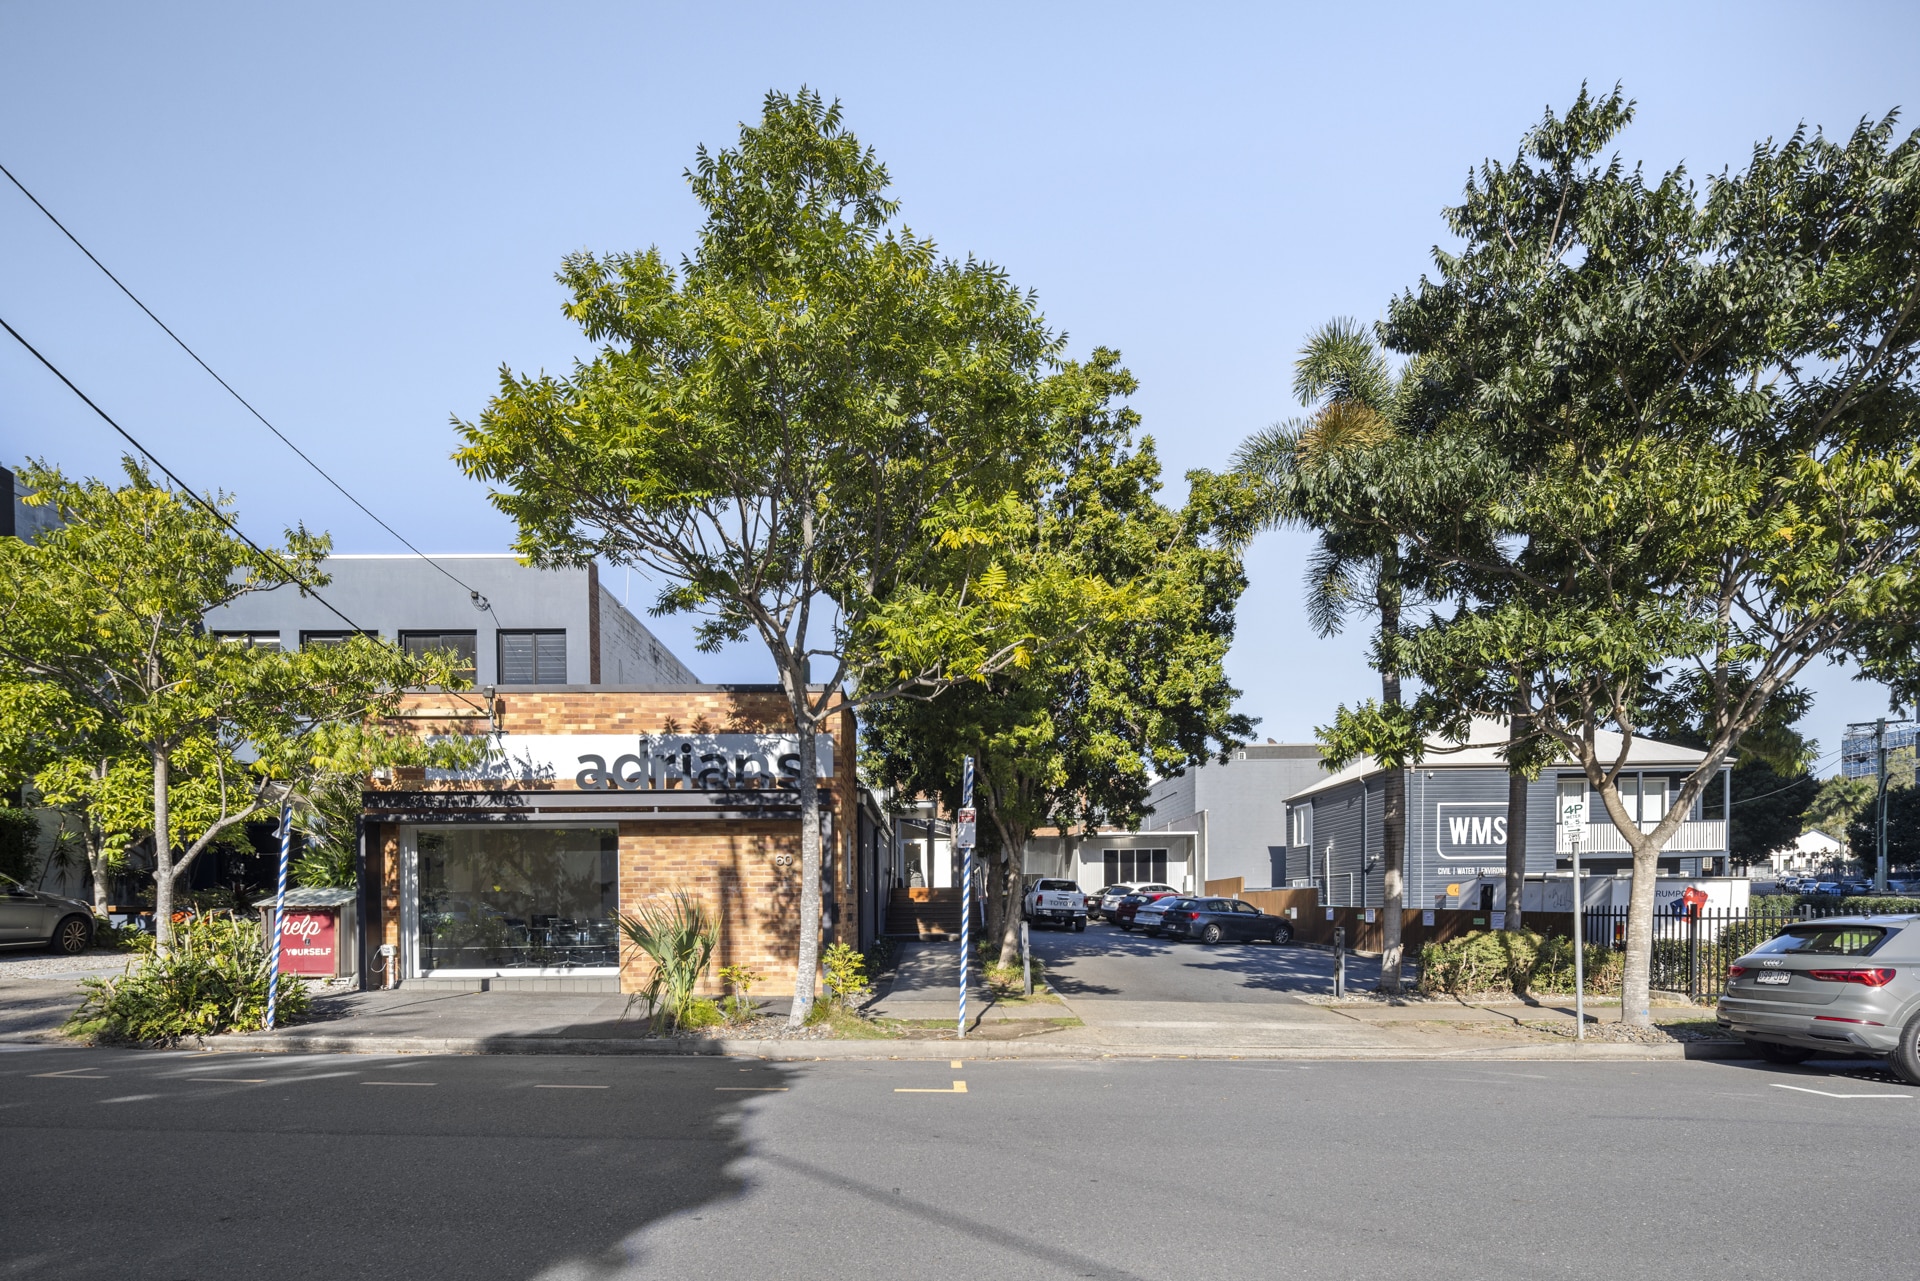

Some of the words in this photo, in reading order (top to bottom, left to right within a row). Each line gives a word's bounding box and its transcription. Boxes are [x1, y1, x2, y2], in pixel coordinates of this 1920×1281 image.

[575, 739, 801, 790] adrians
[1564, 804, 1583, 814] 4P
[1448, 816, 1507, 845] WMS
[776, 854, 793, 867] 60
[1437, 866, 1451, 875] CIVIL
[1457, 866, 1475, 875] WATER
[281, 914, 321, 941] help
[286, 948, 331, 956] YOURSELF
